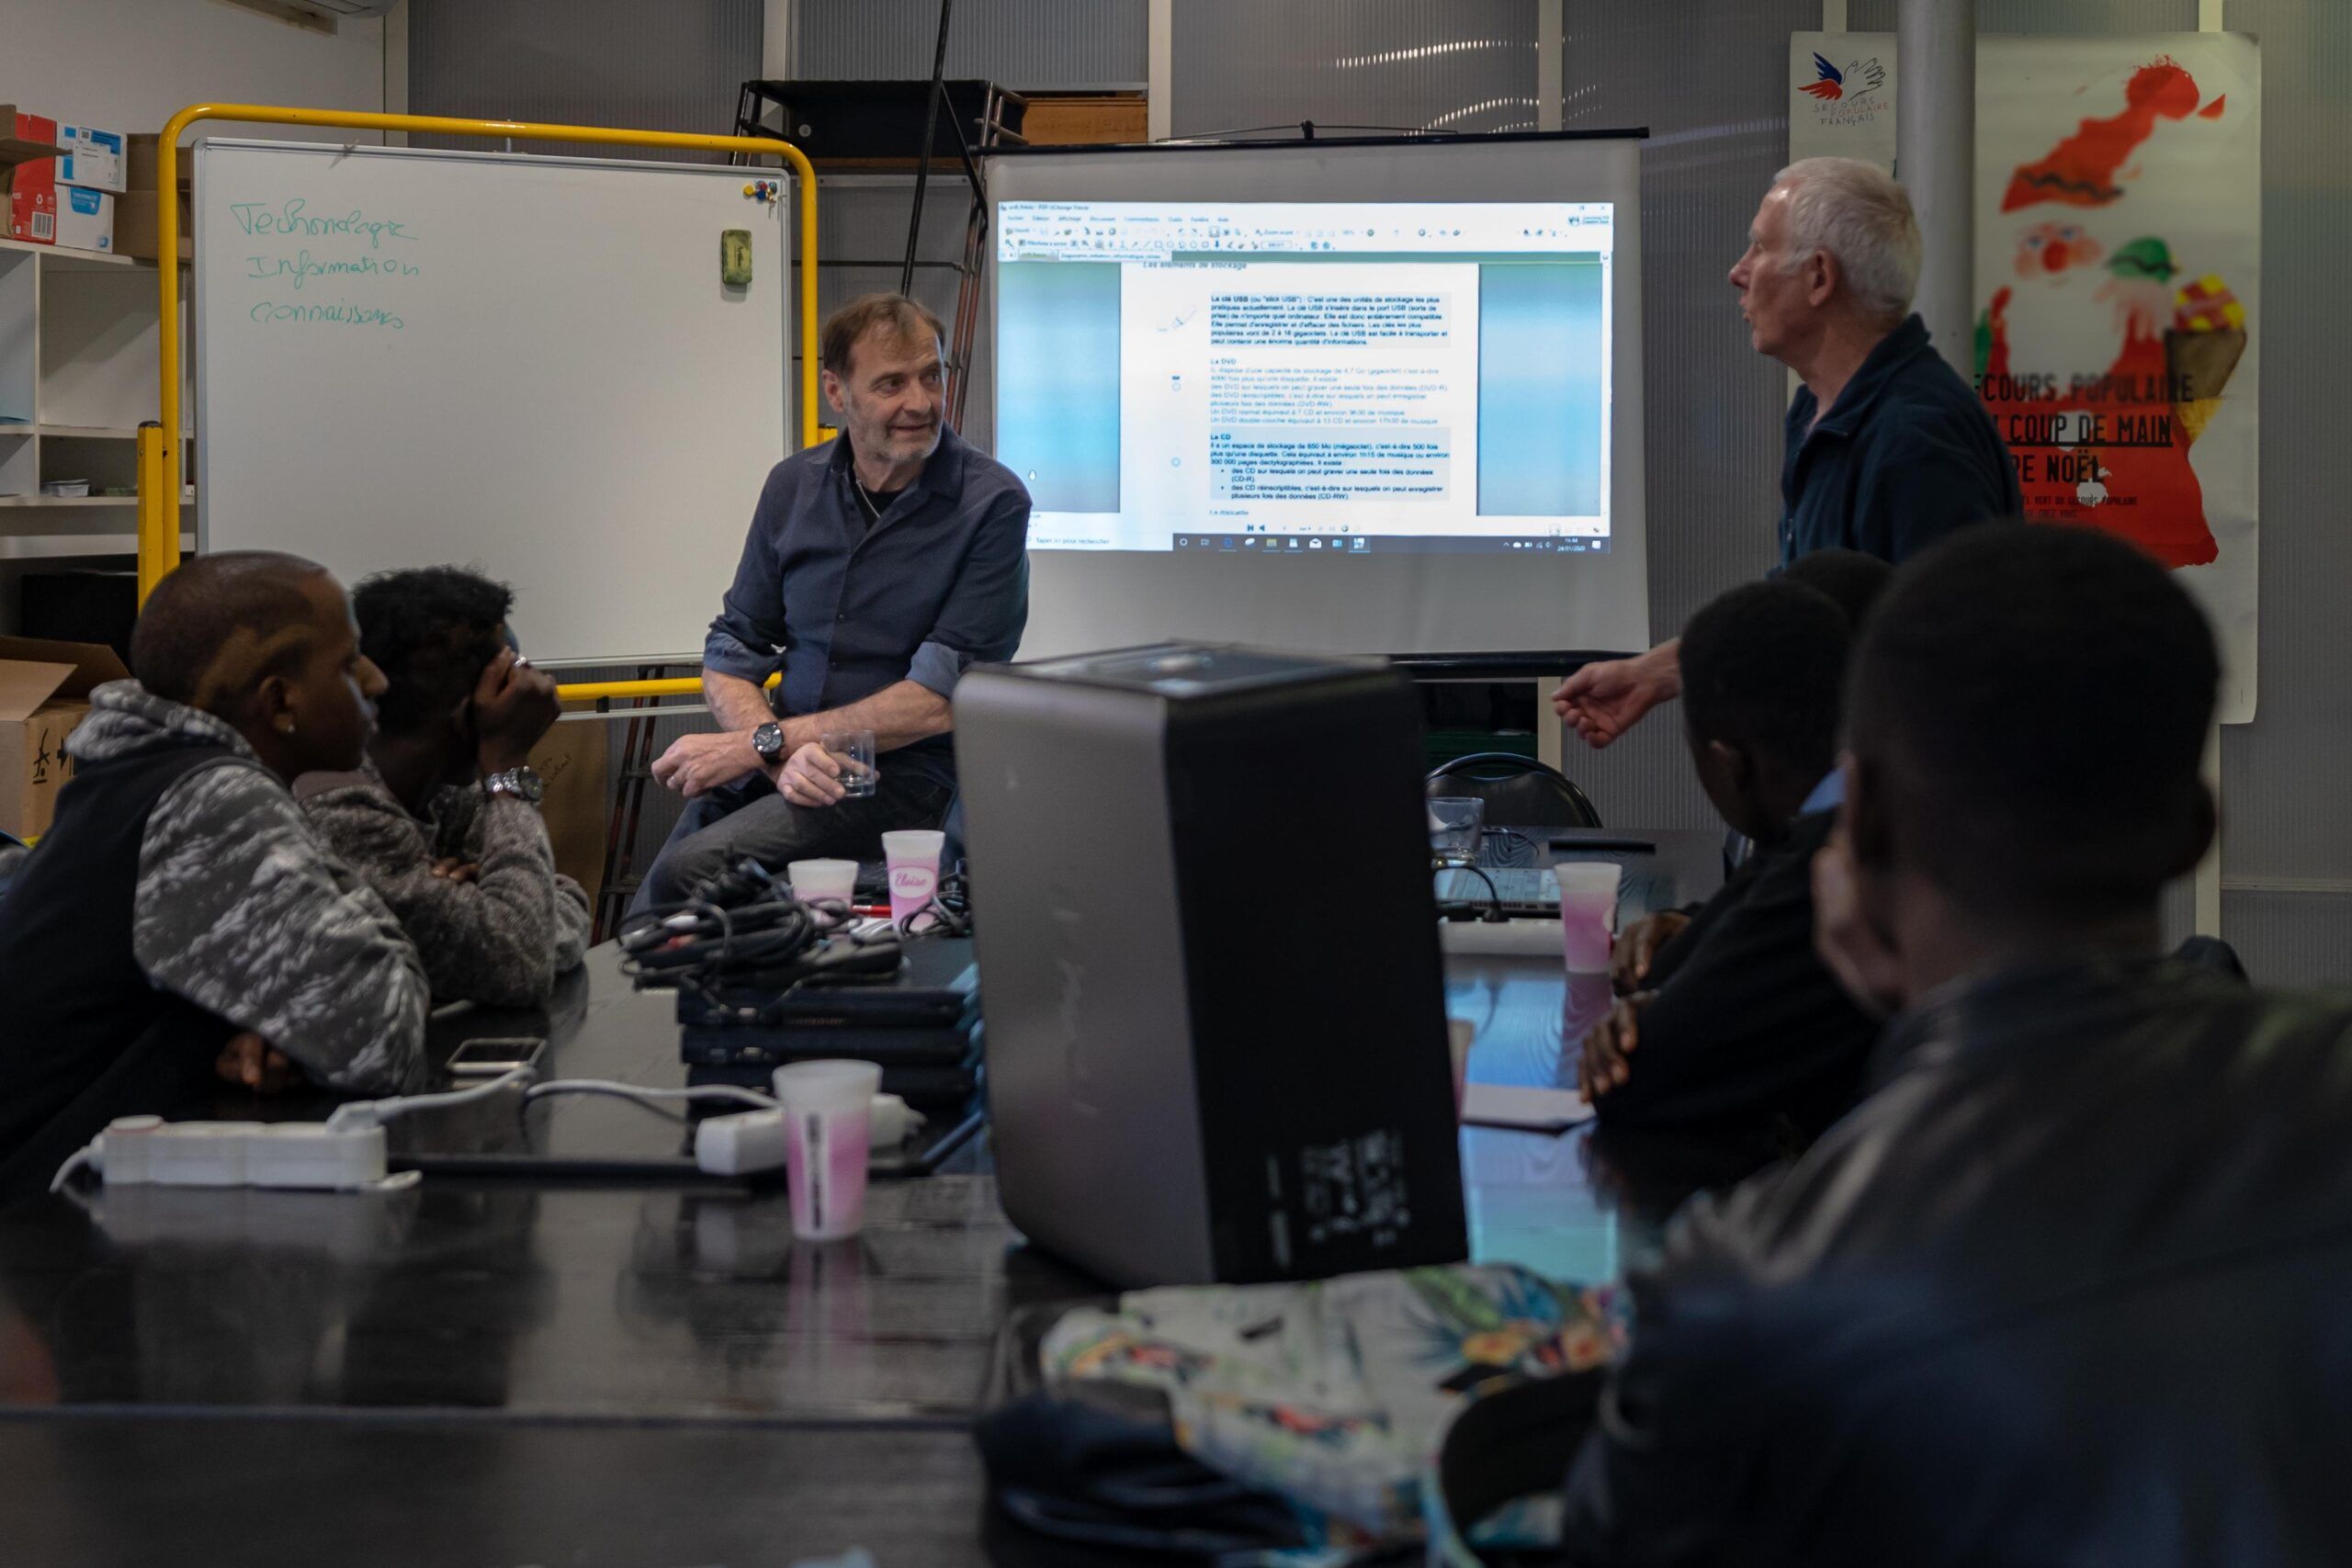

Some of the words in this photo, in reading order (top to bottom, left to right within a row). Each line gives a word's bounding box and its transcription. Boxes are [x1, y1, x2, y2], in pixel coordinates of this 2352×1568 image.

[1813, 96, 1874, 113] SECOURS
[1831, 102, 1889, 118] POPULAIRE
[1819, 112, 1874, 126] FRANÇAIS
[247, 249, 419, 290] Information
[2071, 373, 2194, 402] POPULAIRE
[2009, 414, 2067, 443] COUP
[2079, 414, 2106, 443] DE
[2118, 414, 2171, 443] MAIN
[2047, 448, 2104, 482] NOËL
[2068, 496, 2098, 506] SECOURS
[2102, 497, 2138, 506] POPULAIRE
